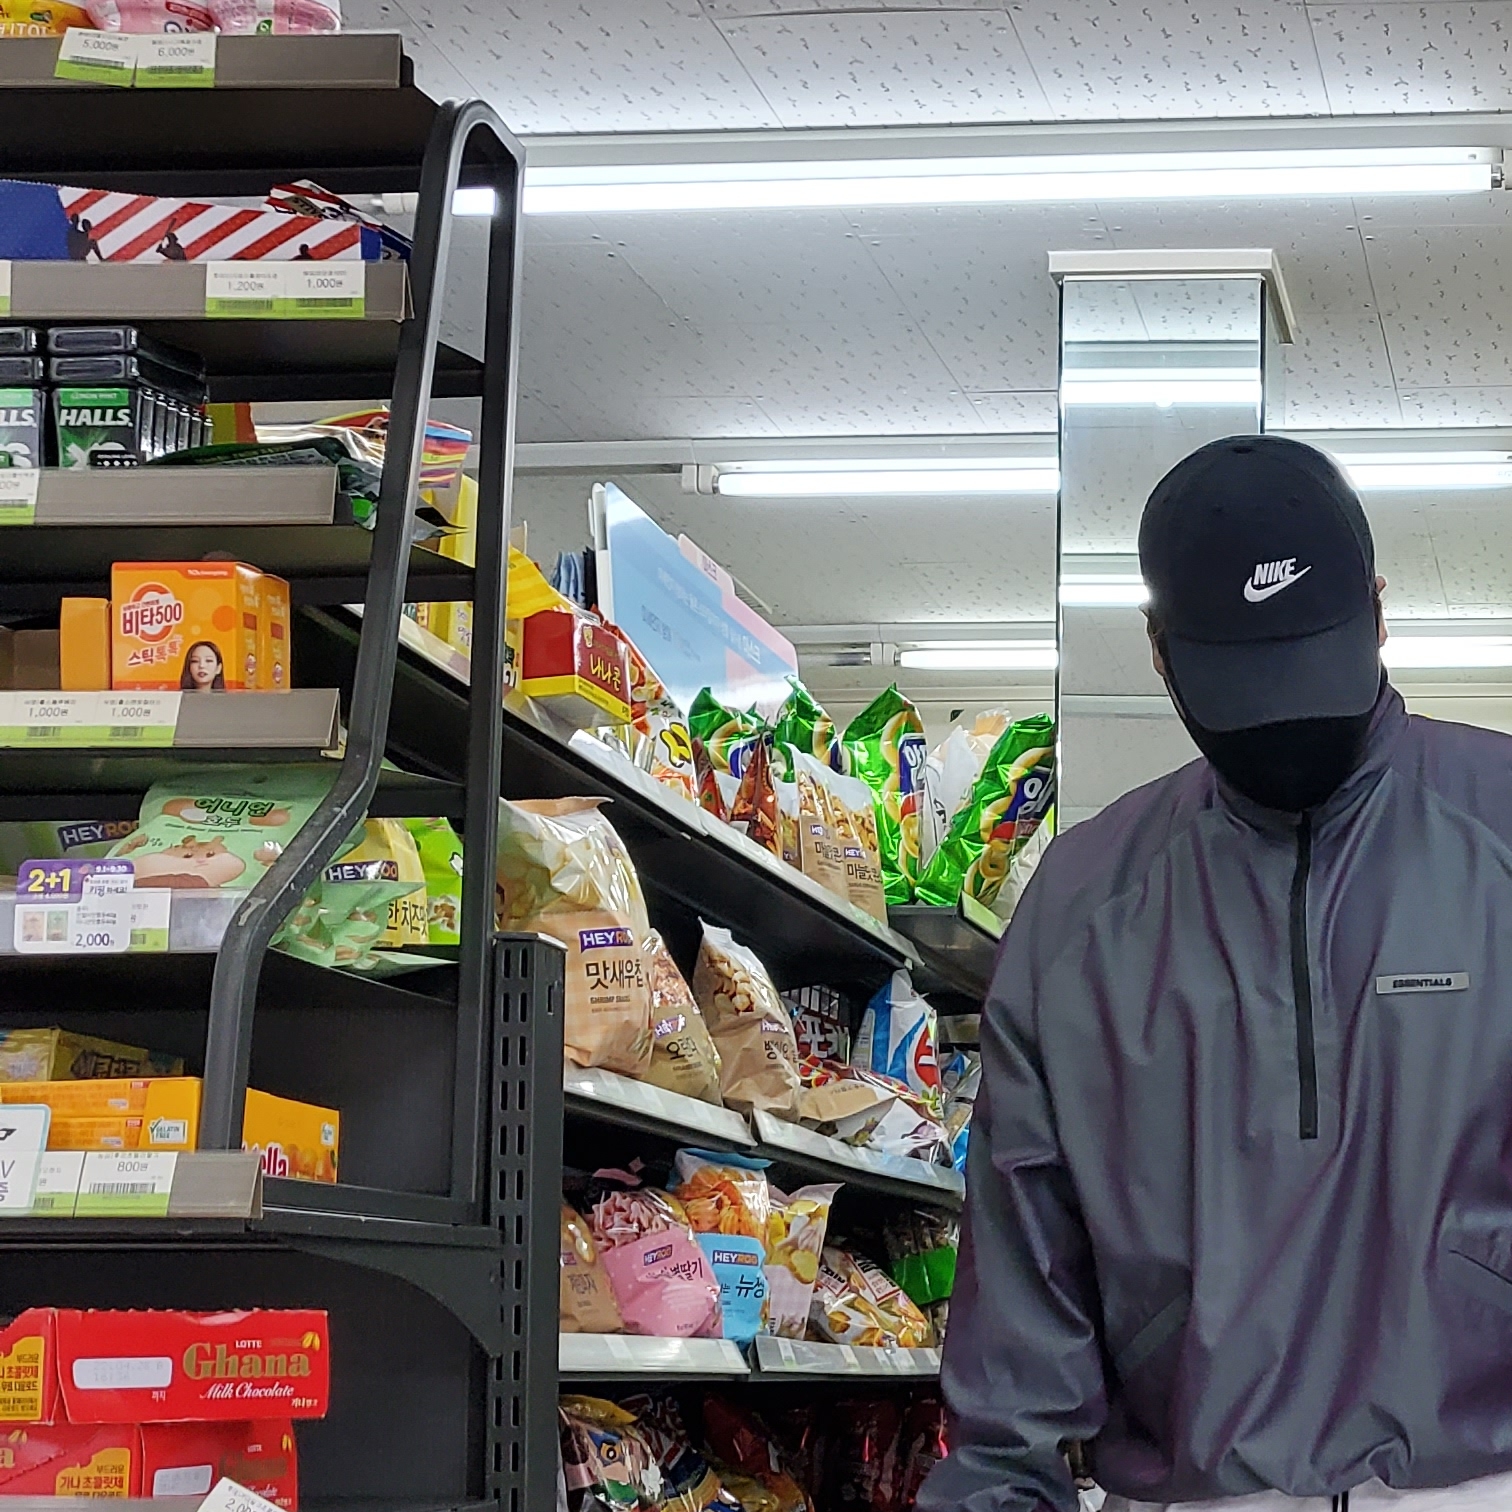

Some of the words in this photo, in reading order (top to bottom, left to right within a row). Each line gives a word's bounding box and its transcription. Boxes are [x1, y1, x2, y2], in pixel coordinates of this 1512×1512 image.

[59, 408, 134, 427] HALLS
[1253, 557, 1297, 585] NIKE
[122, 602, 183, 636] 비타500
[27, 706, 69, 718] 1,000원
[110, 706, 152, 718] 1,000원
[194, 798, 275, 817] 어니언
[27, 868, 72, 893] 2+1
[1393, 977, 1452, 988] ESSENTIALS
[117, 1161, 148, 1172] 800원
[235, 1339, 262, 1349] LOTTE
[183, 1342, 312, 1380] Ghana
[199, 1383, 234, 1400] Milk
[235, 1381, 295, 1399] Chocolate
